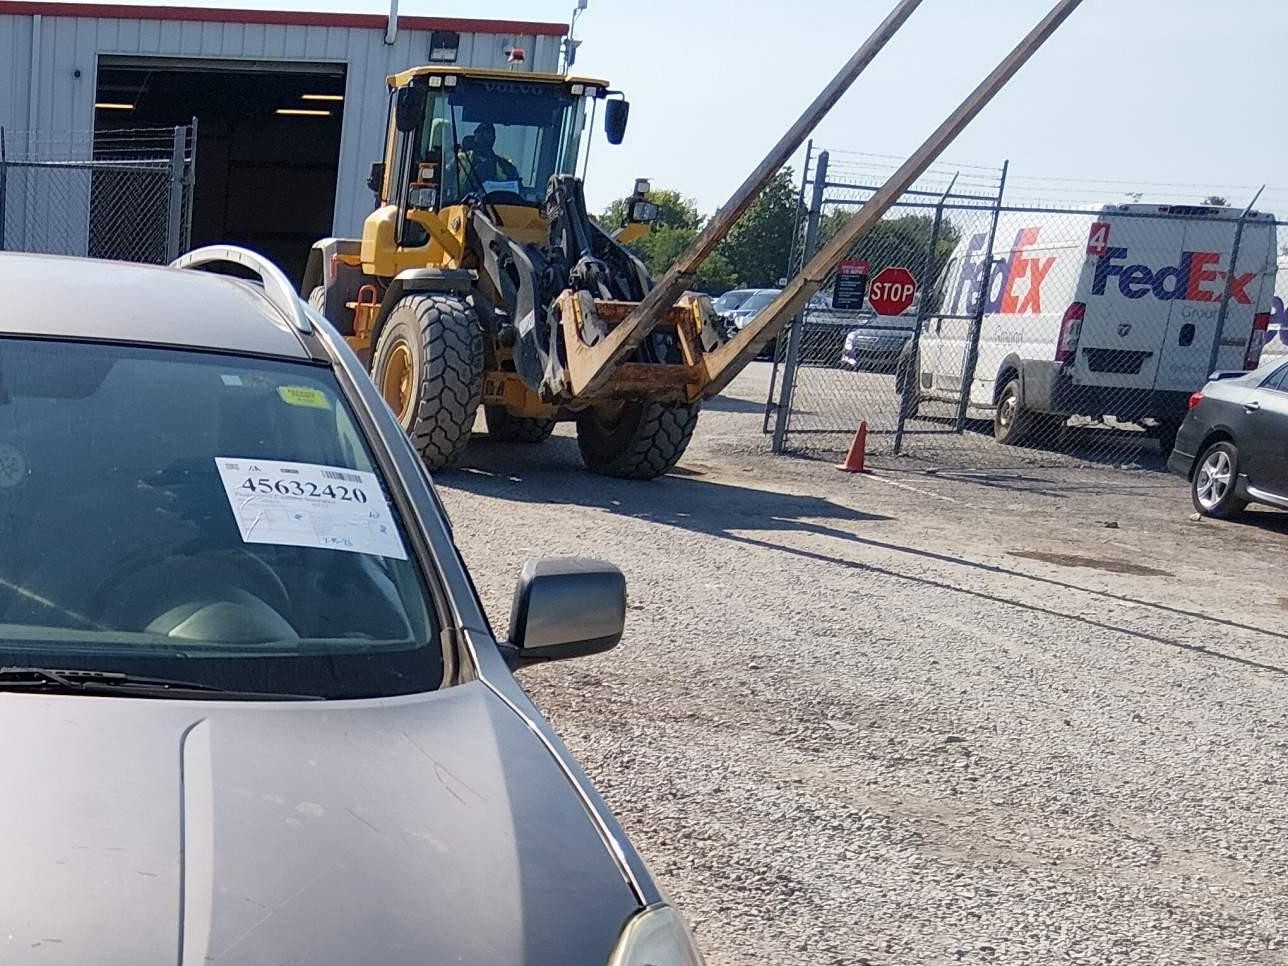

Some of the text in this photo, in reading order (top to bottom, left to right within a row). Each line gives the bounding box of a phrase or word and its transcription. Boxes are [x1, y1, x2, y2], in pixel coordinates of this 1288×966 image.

[1089, 227, 1106, 252] 4
[951, 226, 1057, 314] FedEx
[1092, 247, 1258, 305] FedEx
[872, 282, 914, 303] STOP
[241, 477, 368, 504] 45632420
